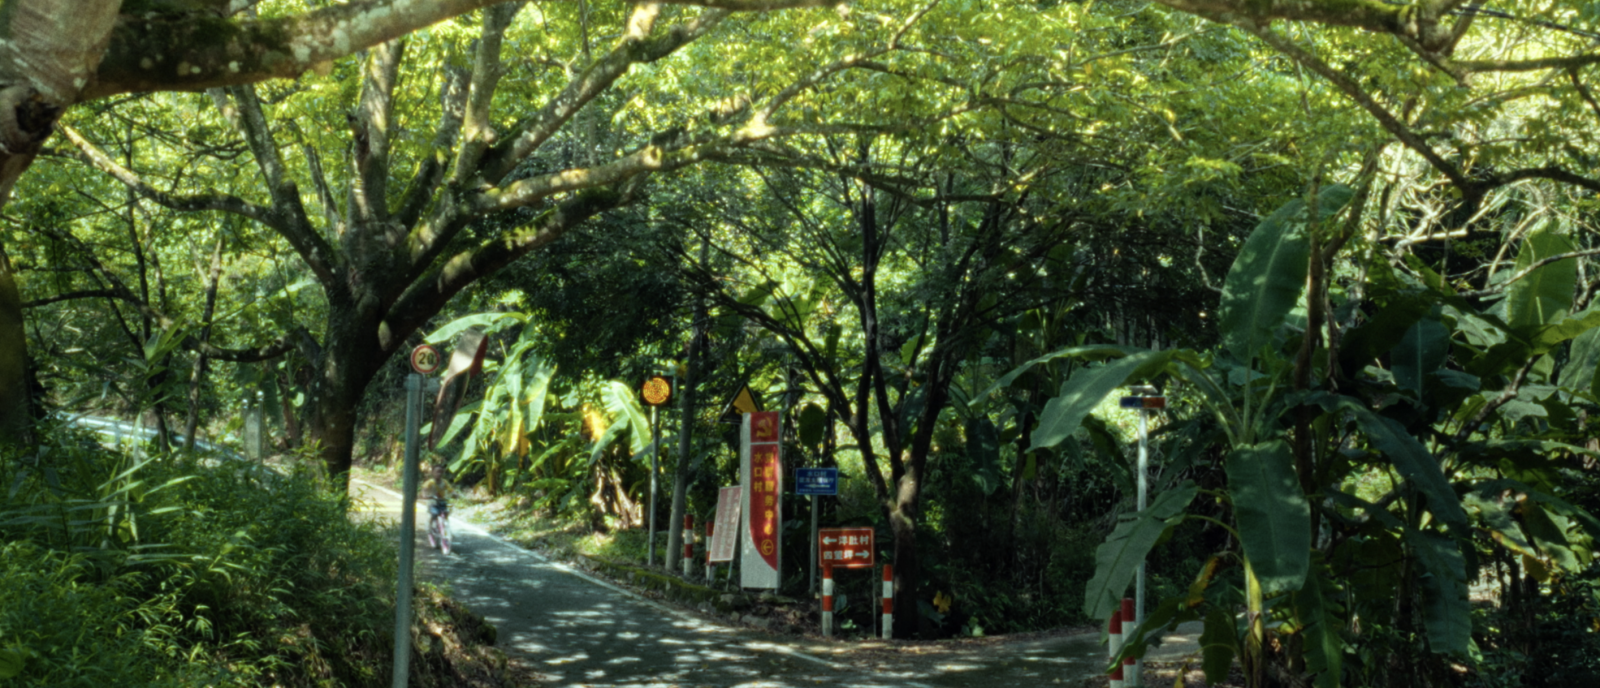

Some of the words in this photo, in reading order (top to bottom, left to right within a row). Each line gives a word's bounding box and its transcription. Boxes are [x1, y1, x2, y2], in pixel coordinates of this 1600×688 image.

[418, 352, 434, 365] 20
[754, 452, 763, 493] 水口村
[764, 452, 775, 535] 党群服务中心
